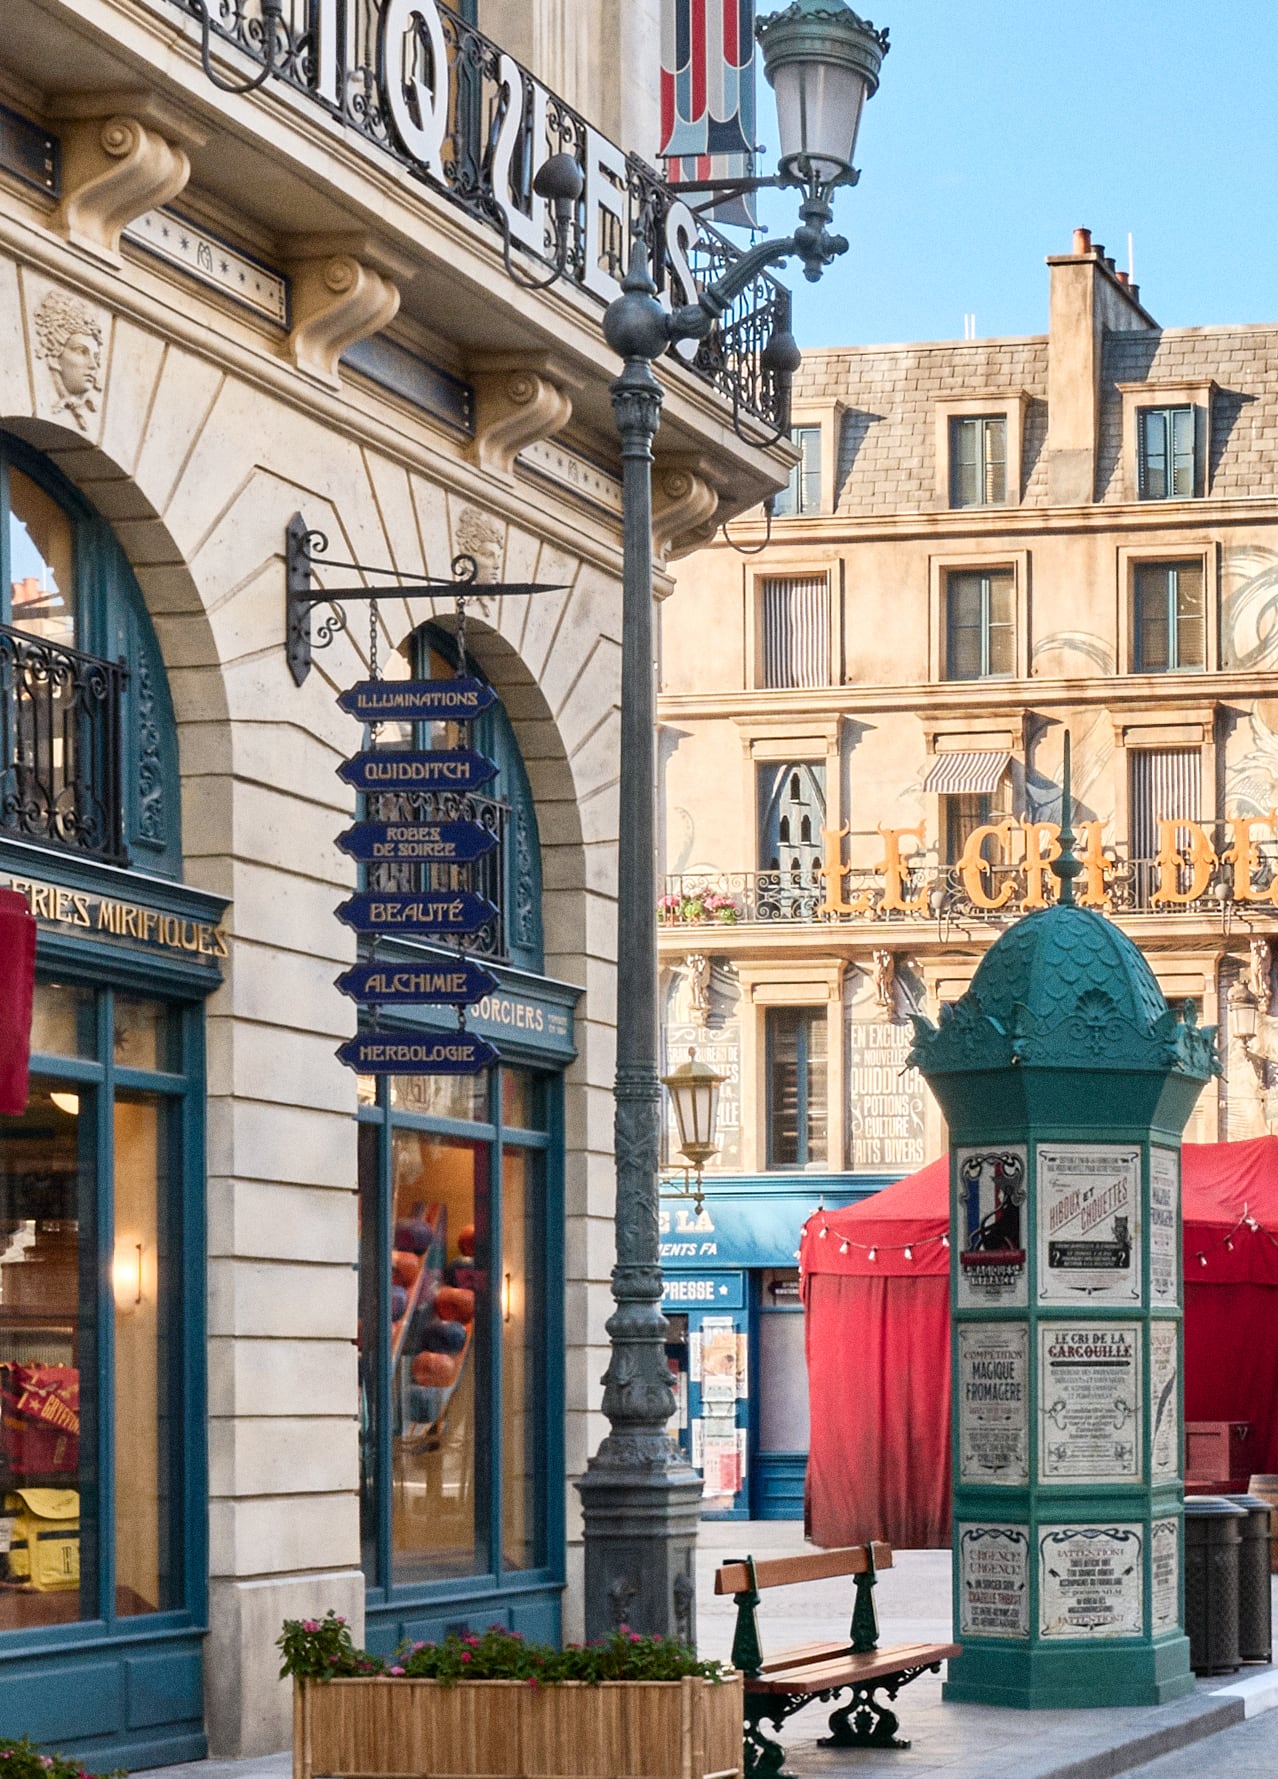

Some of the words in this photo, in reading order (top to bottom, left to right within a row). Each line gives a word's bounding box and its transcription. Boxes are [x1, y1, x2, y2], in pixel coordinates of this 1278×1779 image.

[184, 0, 706, 363] IQUES
[357, 691, 479, 708] ILLUMINATIONS
[364, 762, 471, 780] QUIDDITCH
[386, 827, 441, 841] ROBES
[373, 843, 396, 856] DE
[818, 817, 931, 919] LE
[956, 811, 1113, 915] CRI
[369, 898, 465, 922] BEAUTÉ
[97, 899, 229, 958] MIRIFIQUES
[364, 973, 468, 993] ALCHIMIE
[851, 1025, 866, 1048] EN
[869, 1024, 915, 1048] EXCLUS
[359, 1045, 476, 1062] HERBOLOGIE
[863, 1095, 910, 1116] POTIONS
[864, 1117, 910, 1137] CULTURE
[884, 1138, 924, 1164] DIVERS
[1080, 1176, 1128, 1231] CHOUETTES
[1083, 1186, 1095, 1202] ET
[1049, 1189, 1081, 1230] HIBOUX
[676, 1209, 715, 1233] LA
[700, 1242, 717, 1255] FA
[662, 1281, 715, 1300] PRESSE
[1055, 1333, 1069, 1345] LE
[1071, 1333, 1089, 1344] CRI
[1093, 1333, 1108, 1344] DE
[1110, 1332, 1126, 1344] LA
[1048, 1345, 1133, 1359] GARGOUILLE
[972, 1361, 1016, 1381] MAGIQUE
